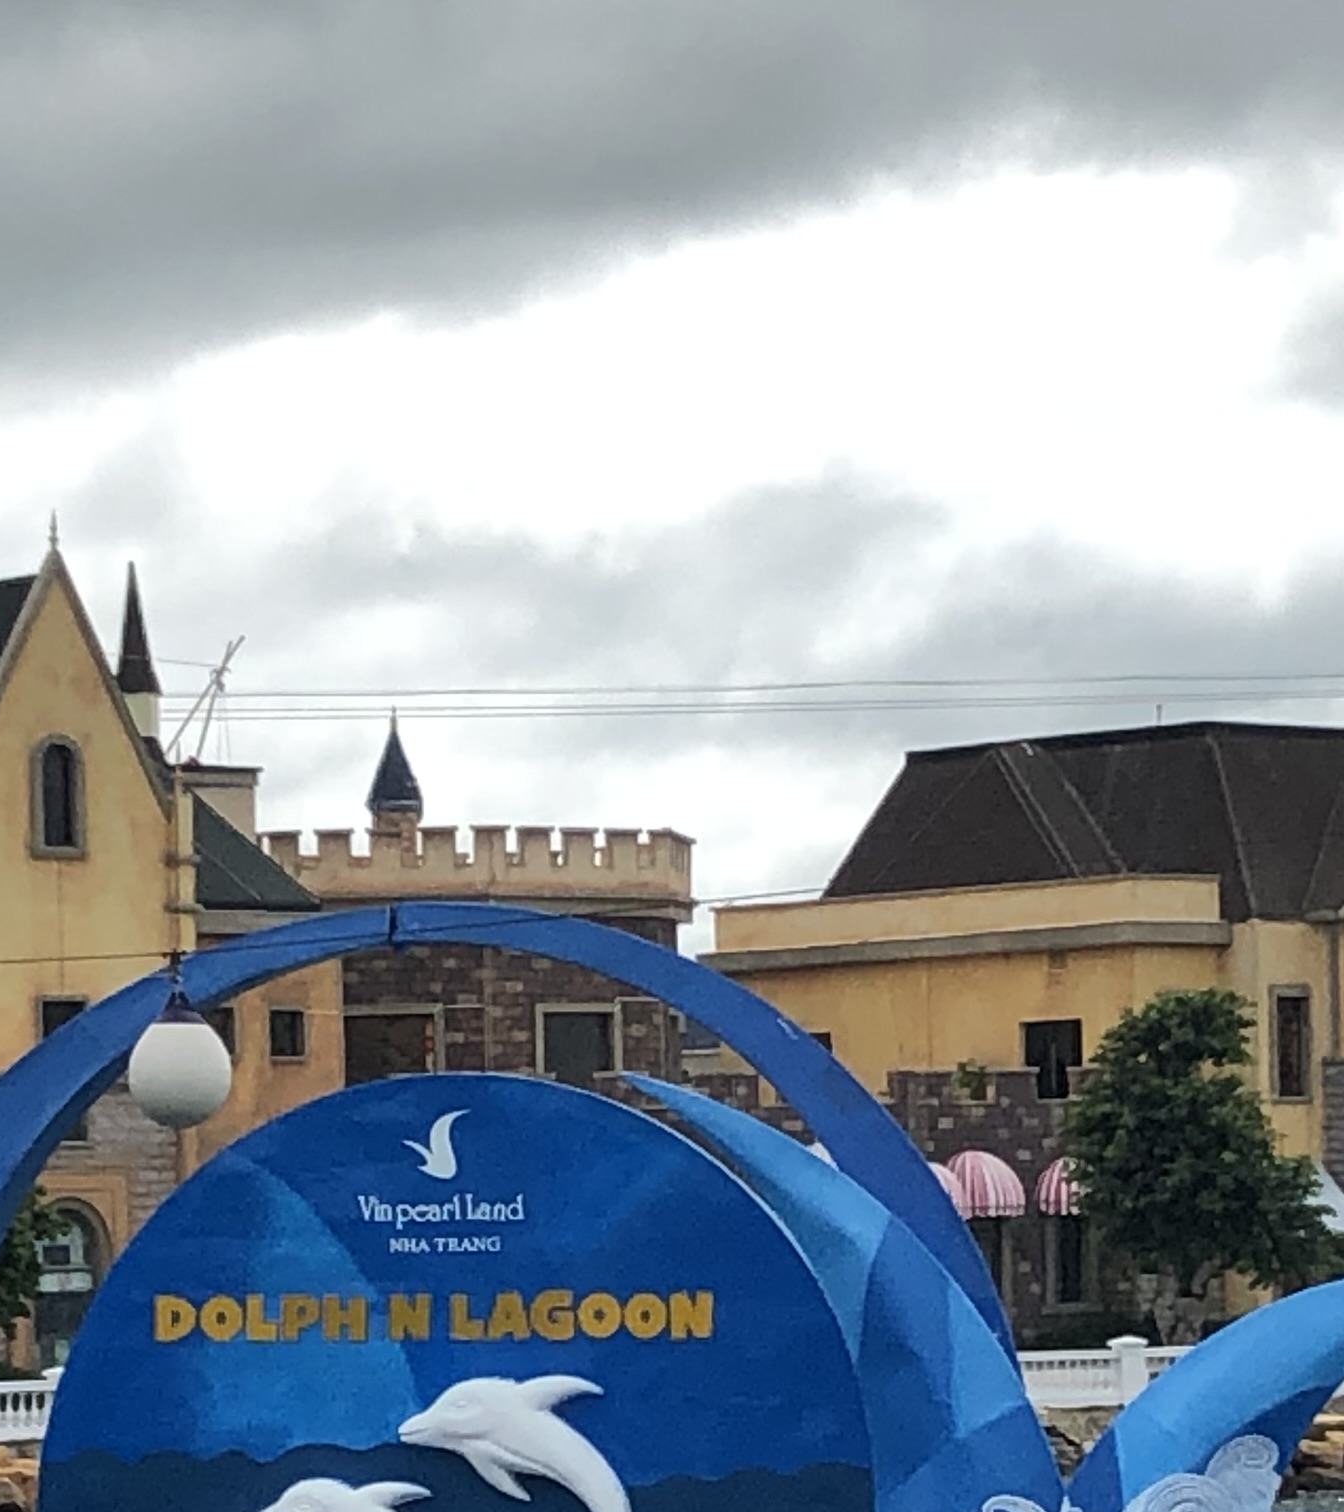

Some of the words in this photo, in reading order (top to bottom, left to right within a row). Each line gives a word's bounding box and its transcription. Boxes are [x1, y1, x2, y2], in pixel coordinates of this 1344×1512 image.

[358, 1193, 460, 1230] Vinpearl
[465, 1193, 525, 1221] Land
[389, 1237, 430, 1253] NHA
[433, 1236, 501, 1252] TRANG
[153, 1293, 432, 1341] DOLPHN
[449, 1289, 714, 1341] LAGOON
